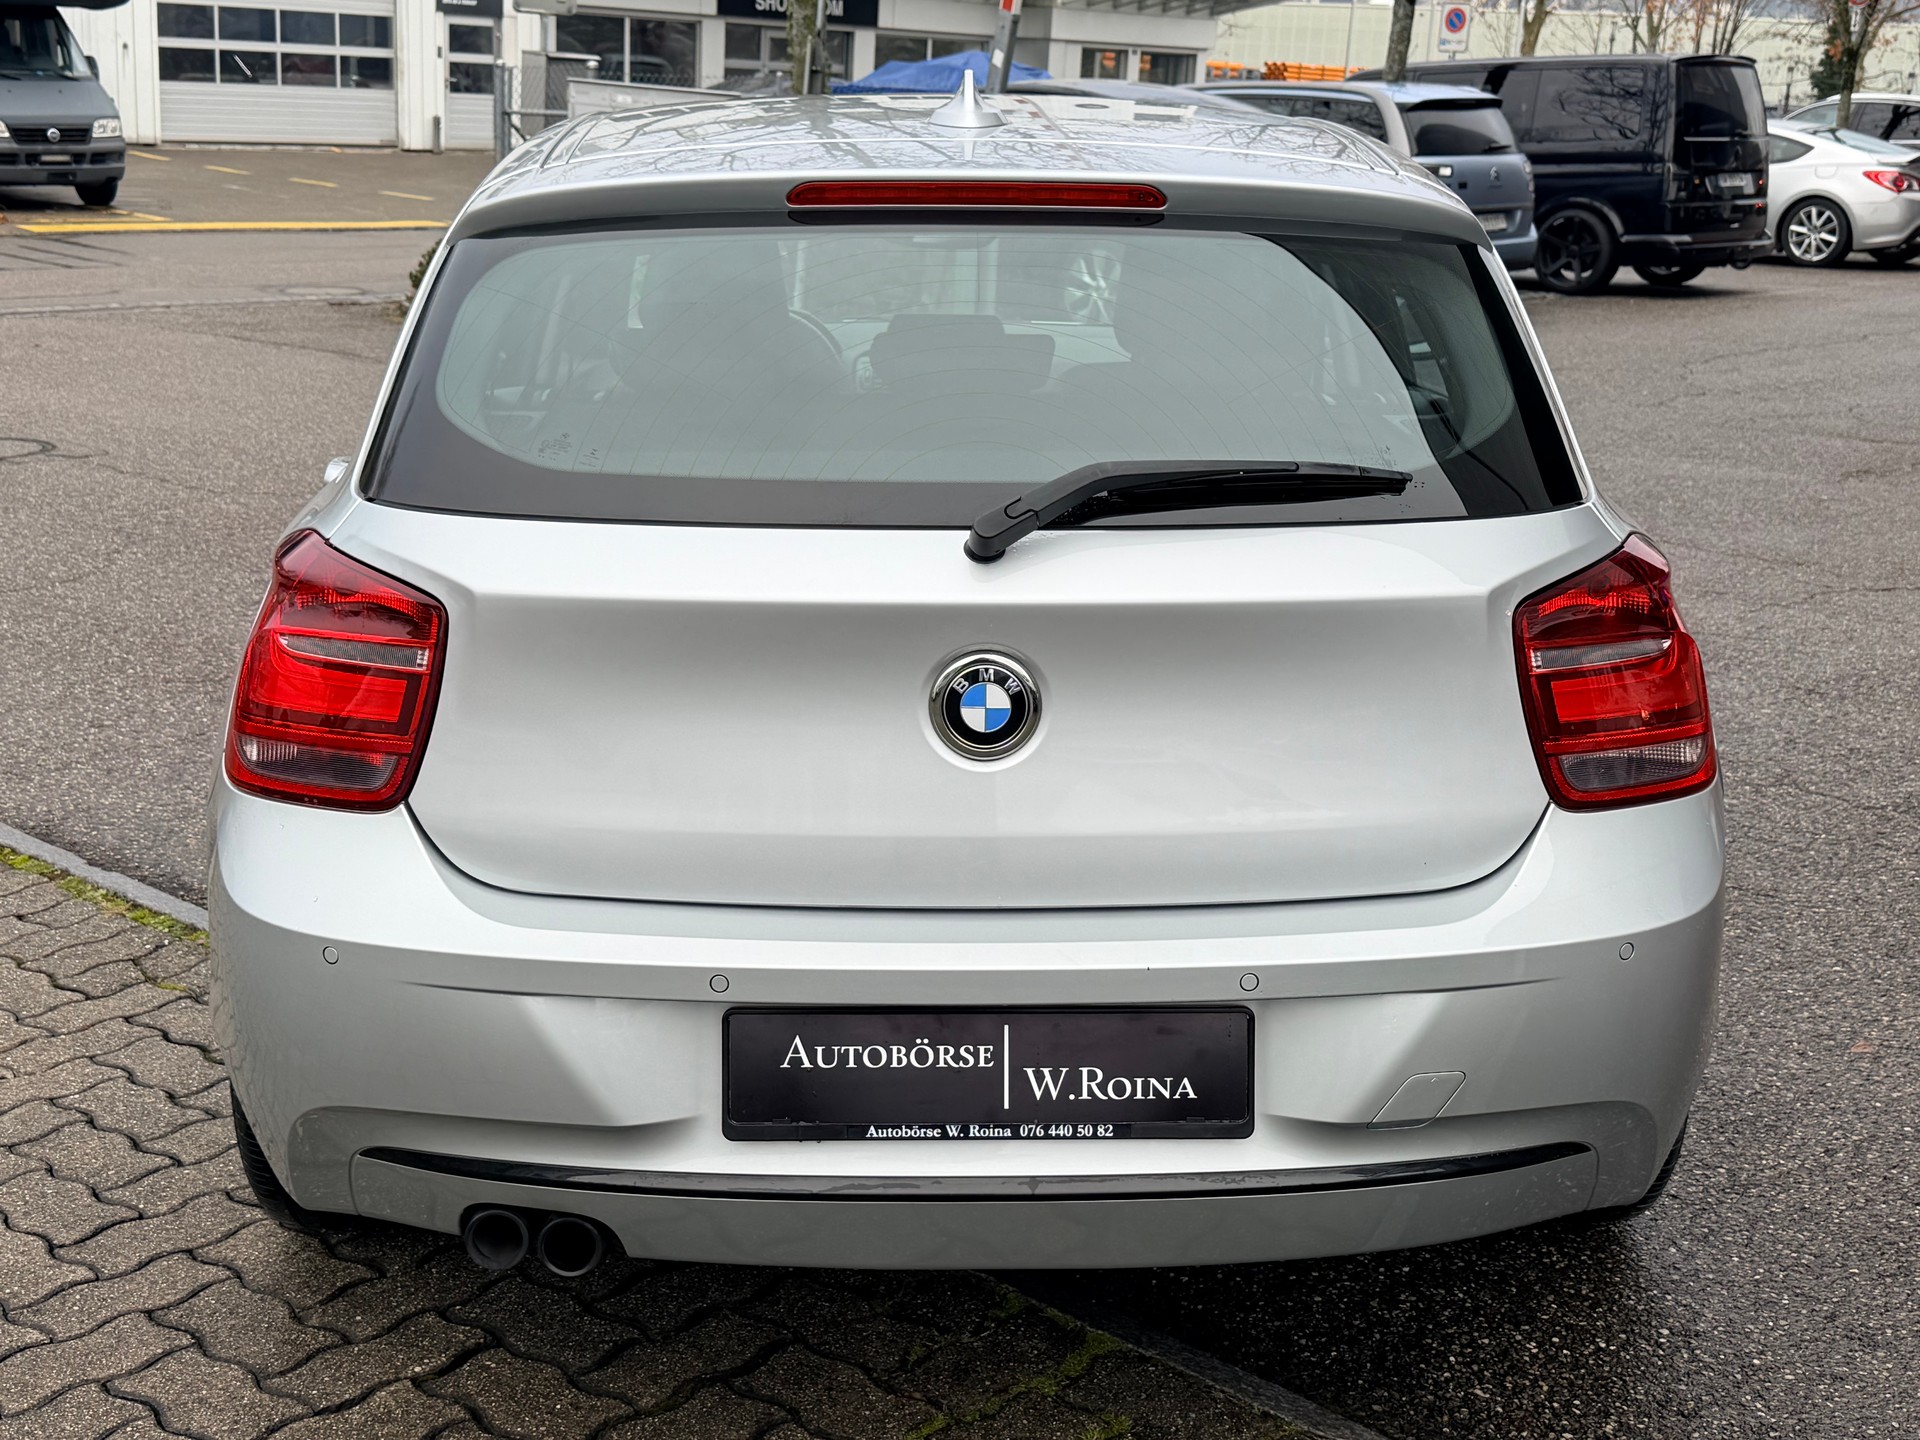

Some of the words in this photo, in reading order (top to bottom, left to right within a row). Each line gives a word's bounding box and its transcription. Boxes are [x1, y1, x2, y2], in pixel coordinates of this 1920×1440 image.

[952, 668, 1022, 696] BMW
[865, 1125, 942, 1138] Autobörse
[946, 1125, 964, 1138] W.
[968, 1125, 1012, 1137] Roina
[1019, 1124, 1044, 1137] 076
[1048, 1124, 1073, 1137] 440
[1076, 1124, 1093, 1137] 50
[1097, 1124, 1114, 1137] 82
